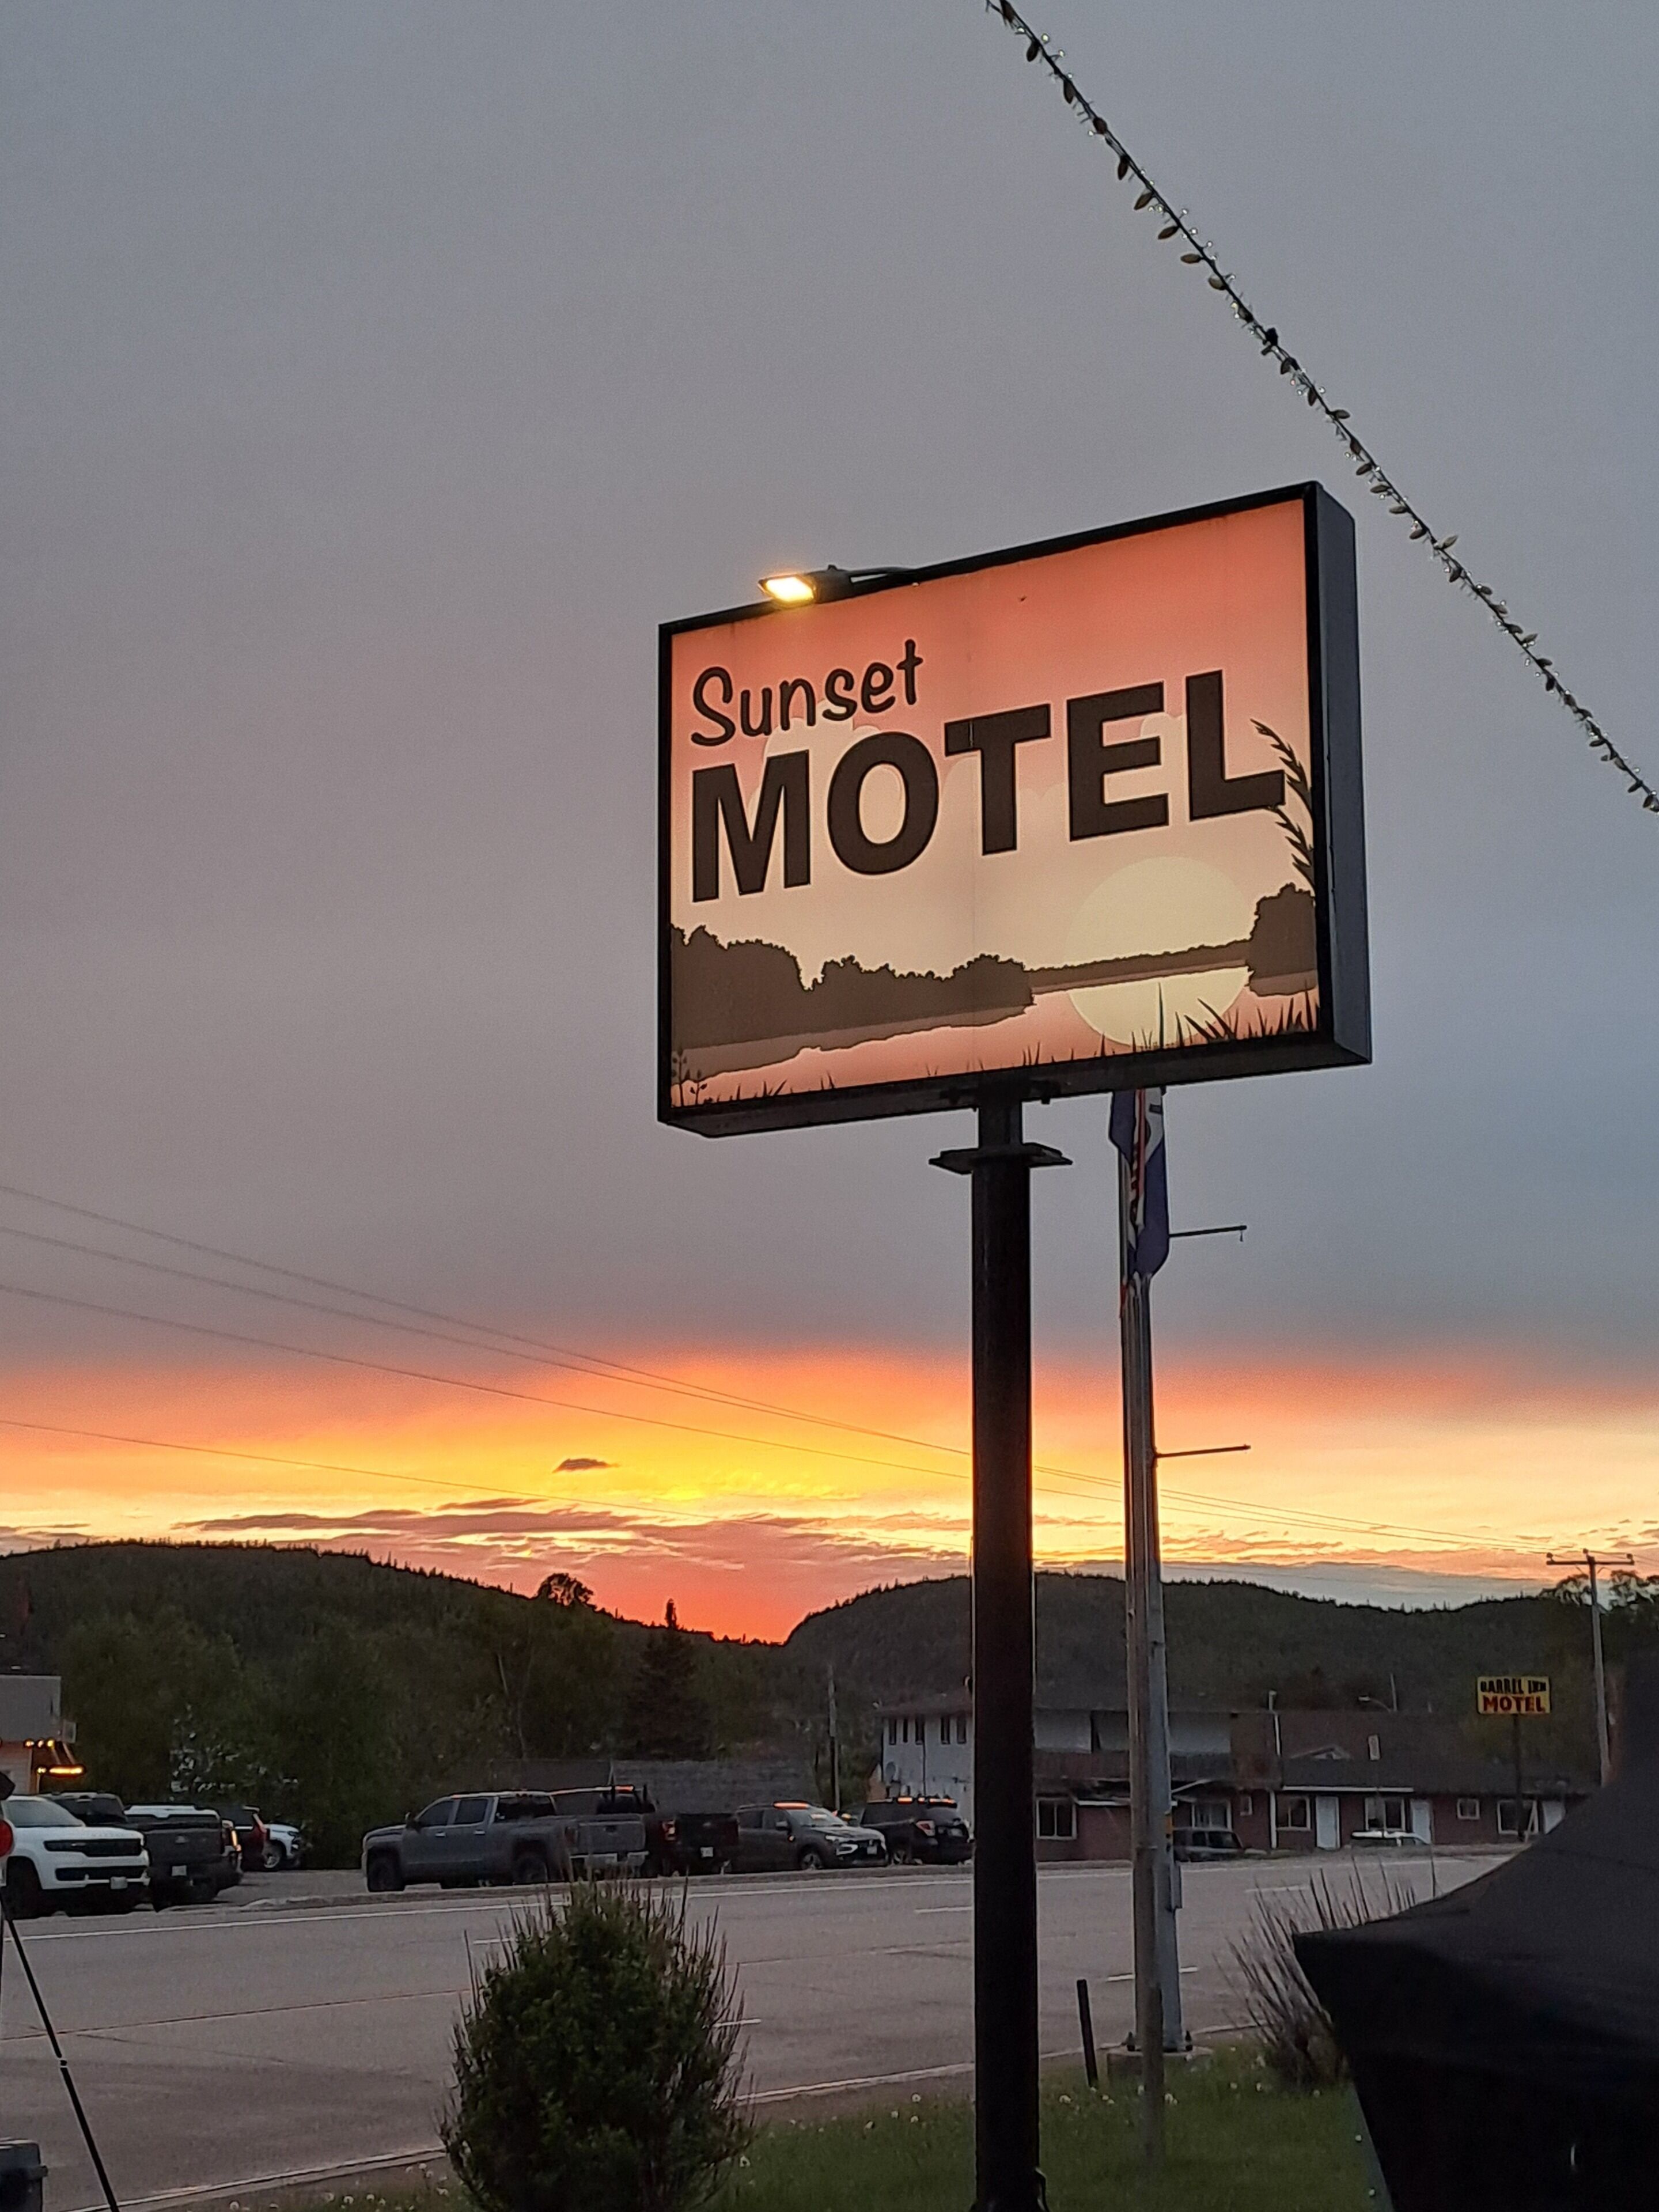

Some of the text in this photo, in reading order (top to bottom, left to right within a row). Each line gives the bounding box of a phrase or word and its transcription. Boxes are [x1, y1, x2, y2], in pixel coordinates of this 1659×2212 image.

[691, 639, 923, 746] Sunset
[692, 669, 1286, 903] MOTEL
[1483, 1695, 1546, 1711] MOTEL
